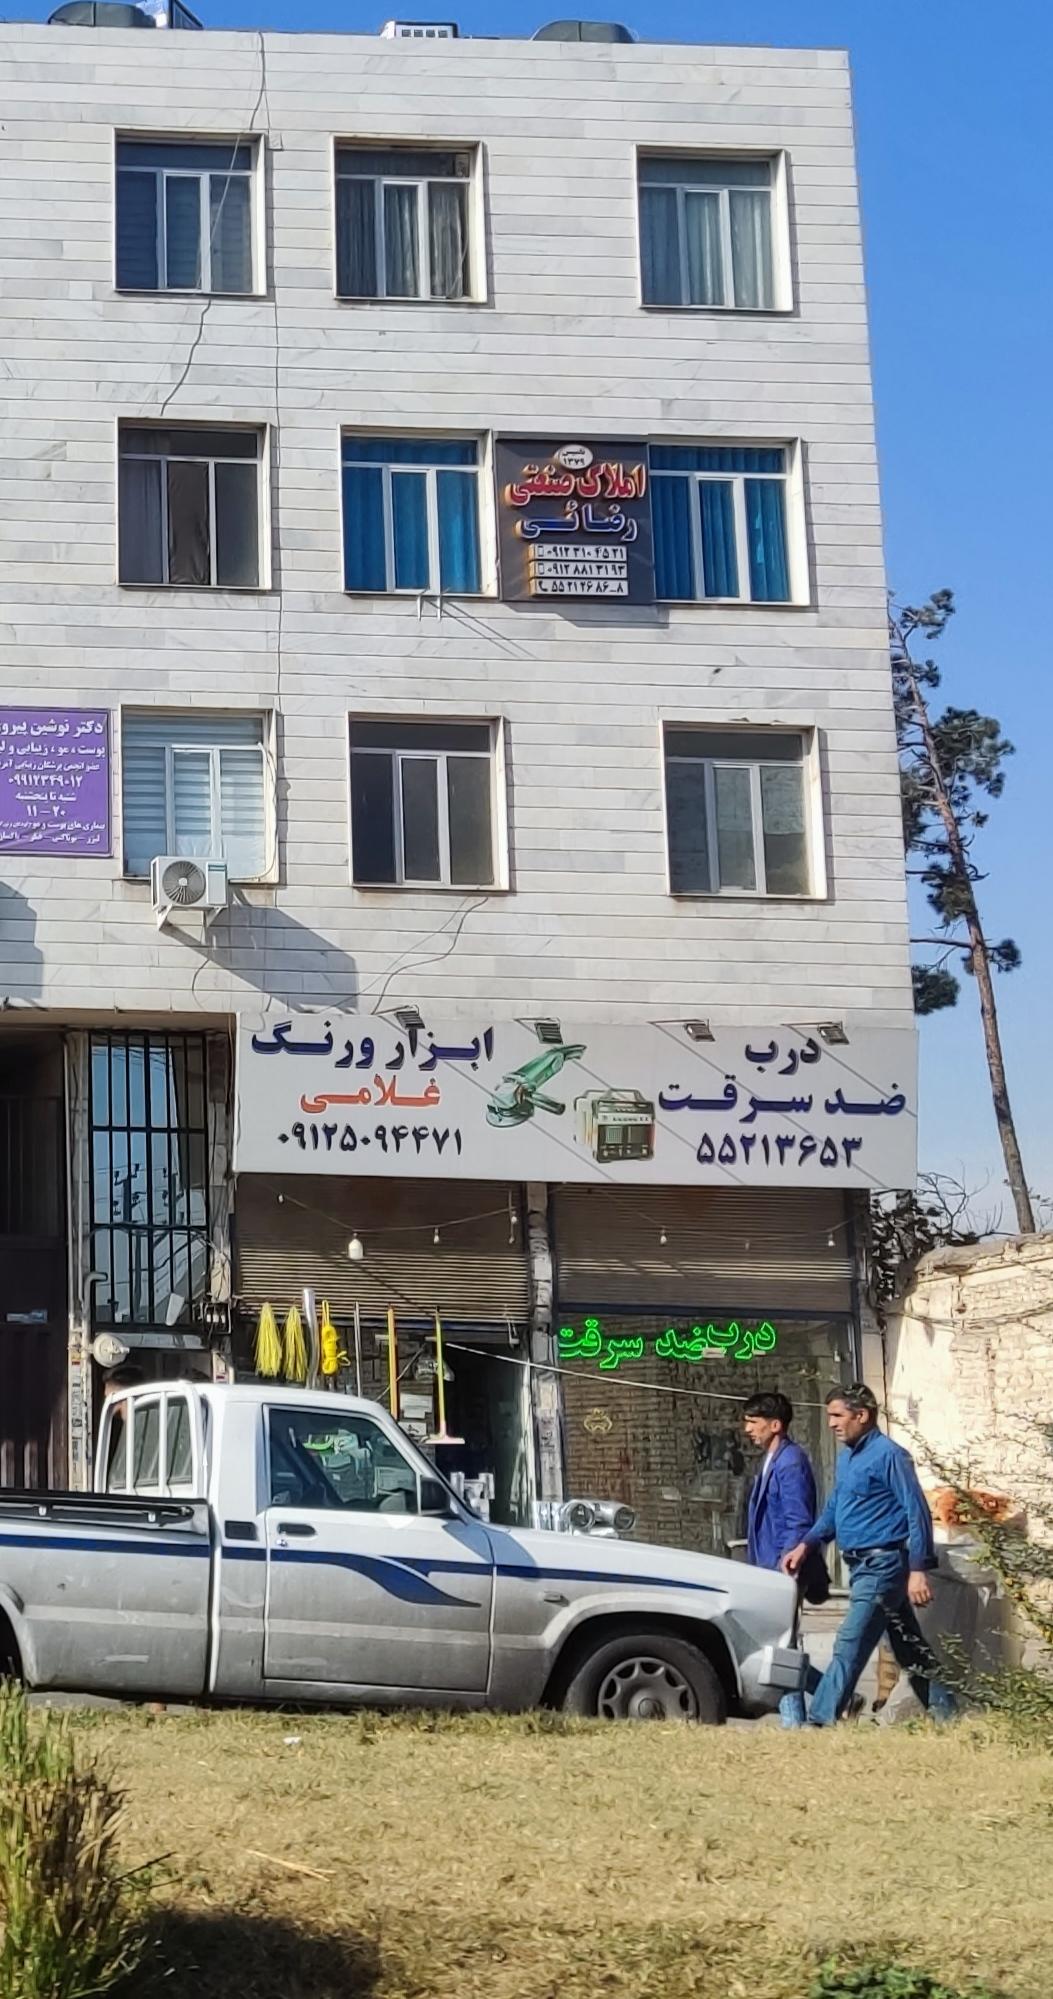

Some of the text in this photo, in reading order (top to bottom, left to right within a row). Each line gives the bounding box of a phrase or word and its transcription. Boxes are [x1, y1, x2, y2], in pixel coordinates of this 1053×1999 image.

[506, 463, 646, 506] املاک صنعتی
[30, 718, 70, 736] نوشین
[72, 720, 103, 737] دکتر
[8, 745, 14, 755] و
[16, 742, 48, 756] زیبایی
[8, 774, 83, 788] ۰۹۹۱۲۳۴۹۰۱۲
[50, 792, 58, 801] تا
[385, 1026, 495, 1071] ابزار
[744, 1037, 821, 1075] درب
[300, 1073, 441, 1114] غلامی
[658, 1074, 907, 1123] ضد سرقت
[277, 1122, 462, 1155] ۰۹۱۲۵۰۹۴۴۷۱
[696, 1132, 863, 1168] ۵۵۲۱۳۶۵۳
[558, 1319, 776, 1369] درب ضد سرقت
